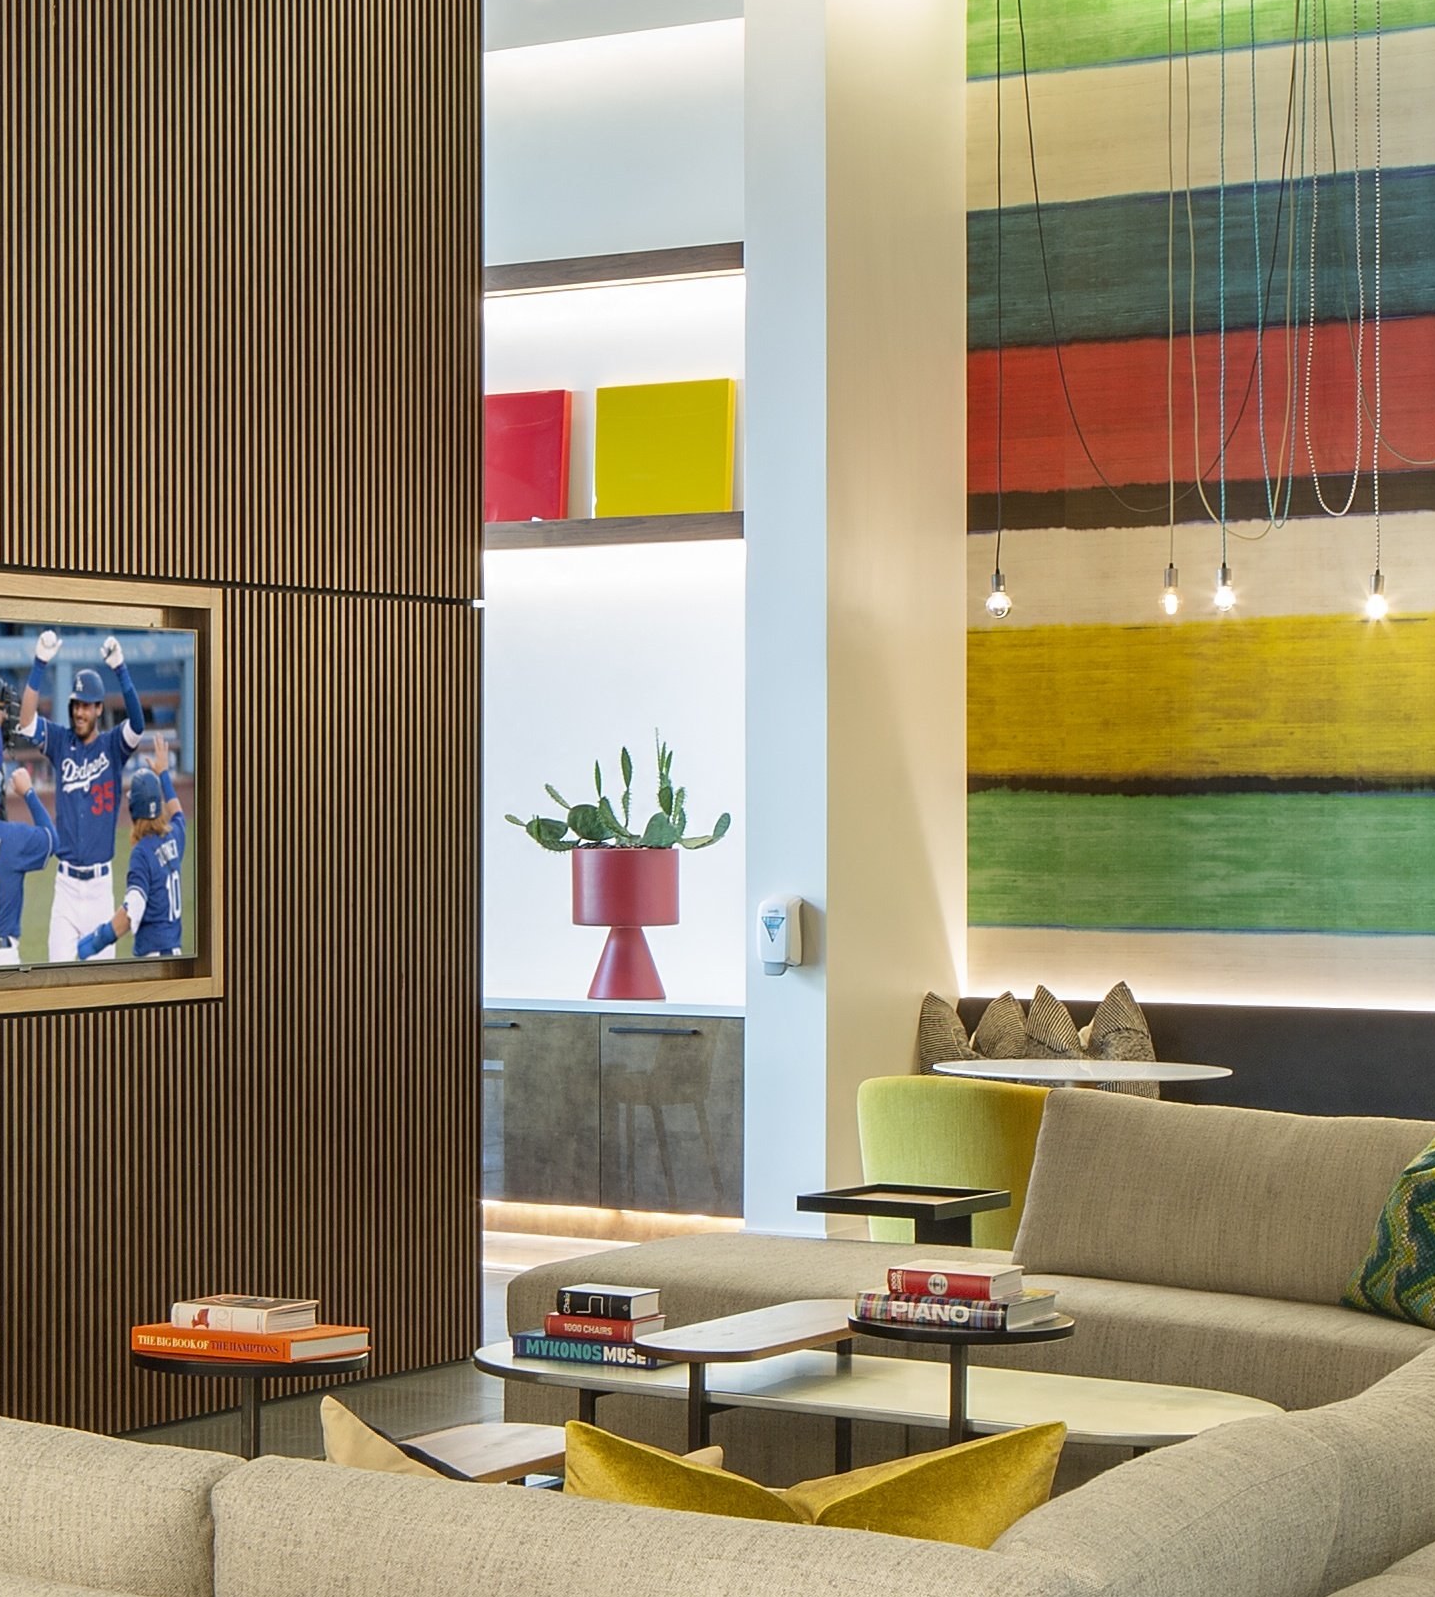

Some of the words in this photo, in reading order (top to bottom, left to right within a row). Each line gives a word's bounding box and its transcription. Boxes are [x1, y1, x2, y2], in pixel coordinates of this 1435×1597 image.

[61, 752, 110, 792] Dodgers
[90, 781, 115, 816] 35
[166, 871, 182, 922] 10
[891, 1301, 970, 1323] PIANO
[563, 1323, 582, 1333] 1000
[582, 1324, 613, 1336] CHAIRS
[137, 1334, 156, 1345] THE
[156, 1336, 172, 1347] BIG
[172, 1338, 196, 1349] BOOK
[196, 1339, 210, 1350] OF
[210, 1340, 228, 1351] THE
[230, 1342, 279, 1354] HAMPTONS
[526, 1339, 602, 1361] MYKONOS
